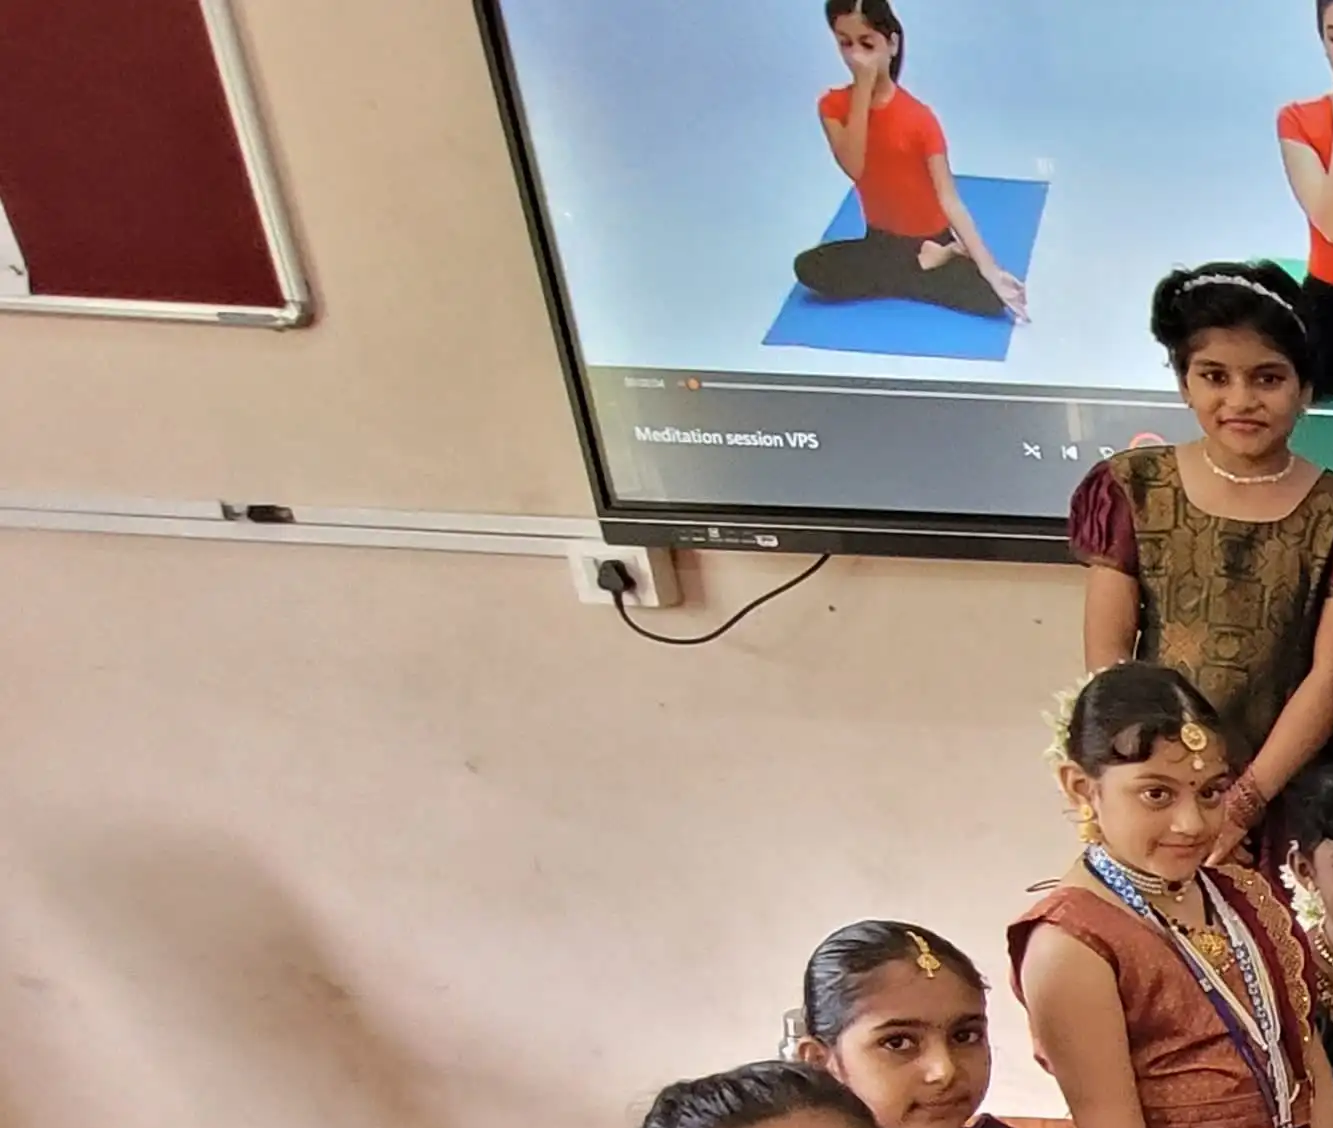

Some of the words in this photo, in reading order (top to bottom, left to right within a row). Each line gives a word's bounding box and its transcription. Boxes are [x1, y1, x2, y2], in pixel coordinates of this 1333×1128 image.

[634, 426, 723, 445] Meditation
[725, 431, 783, 448] session
[784, 432, 819, 449] VPS
